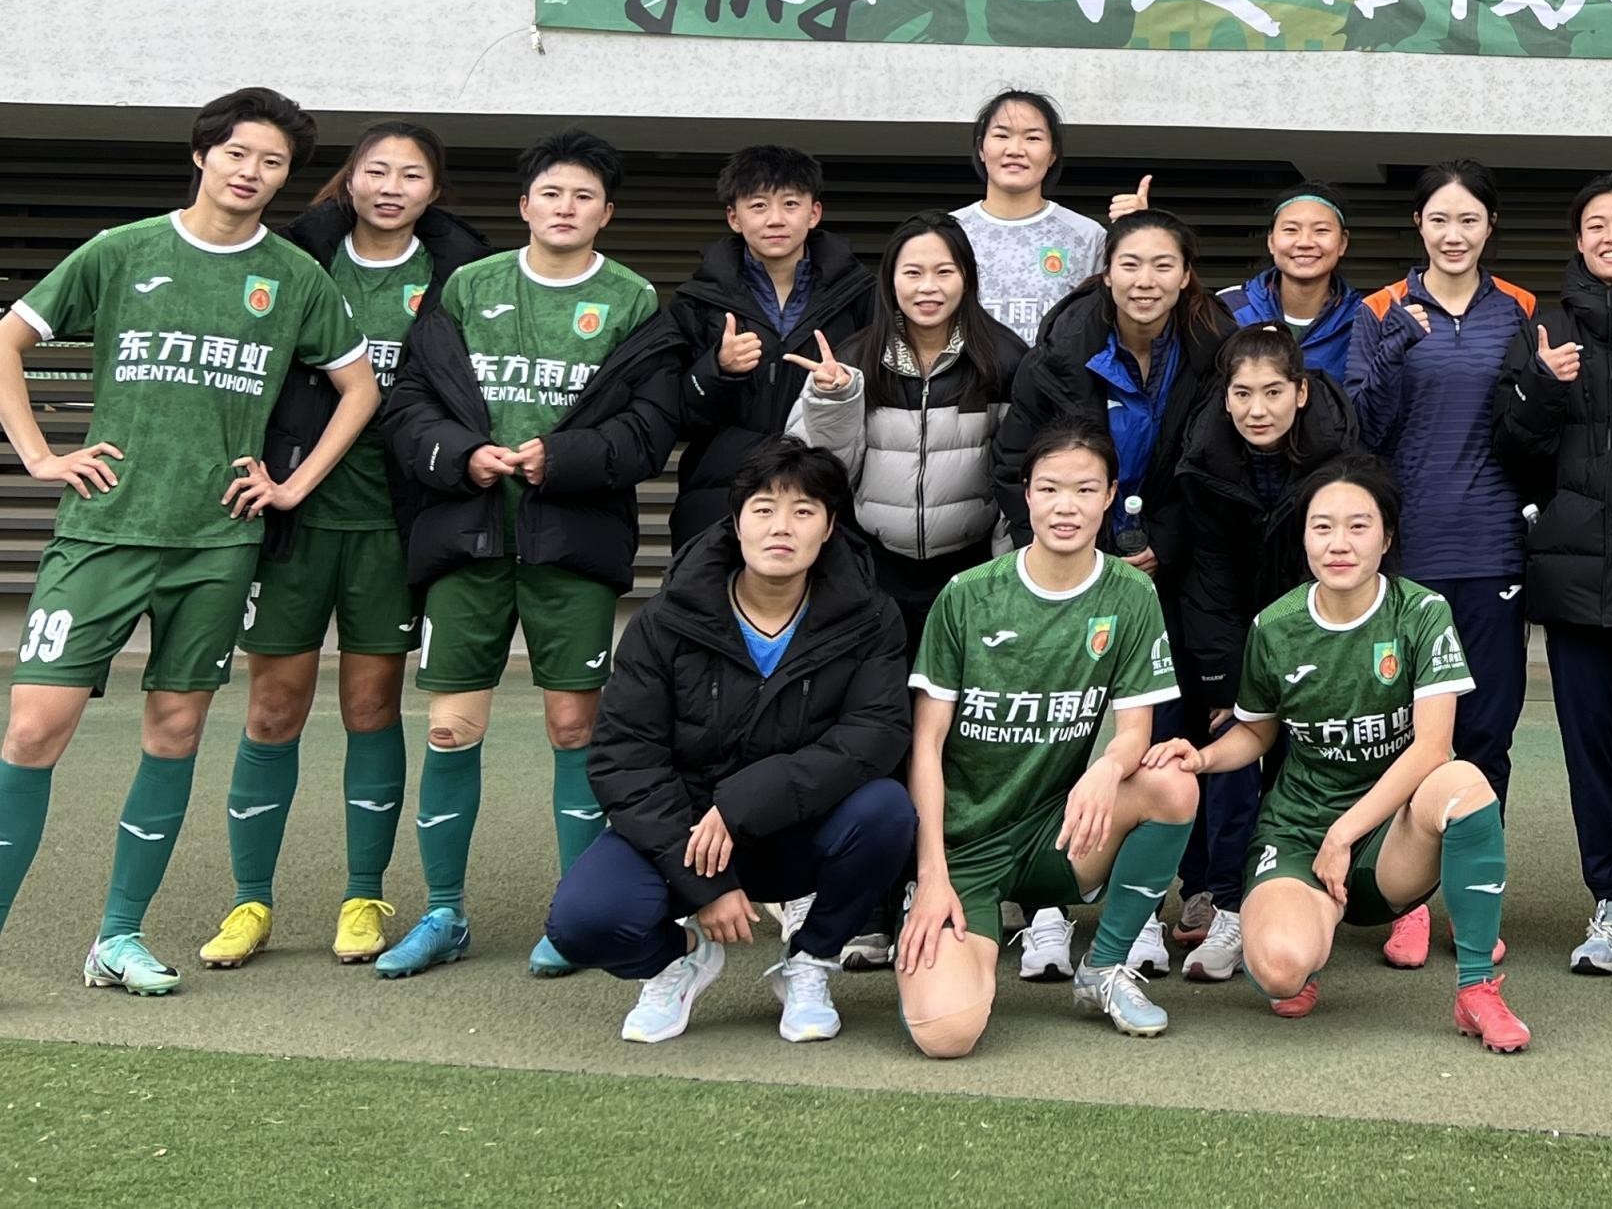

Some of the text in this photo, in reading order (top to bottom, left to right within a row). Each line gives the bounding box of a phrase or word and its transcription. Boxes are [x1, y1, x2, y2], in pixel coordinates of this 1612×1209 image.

[118, 330, 273, 376] 东方雨虹
[115, 365, 264, 396] ORIENTAL YUHONG
[20, 608, 73, 662] 39
[962, 686, 1108, 723] 东方雨虹
[960, 721, 1045, 744] ORIENTAL
